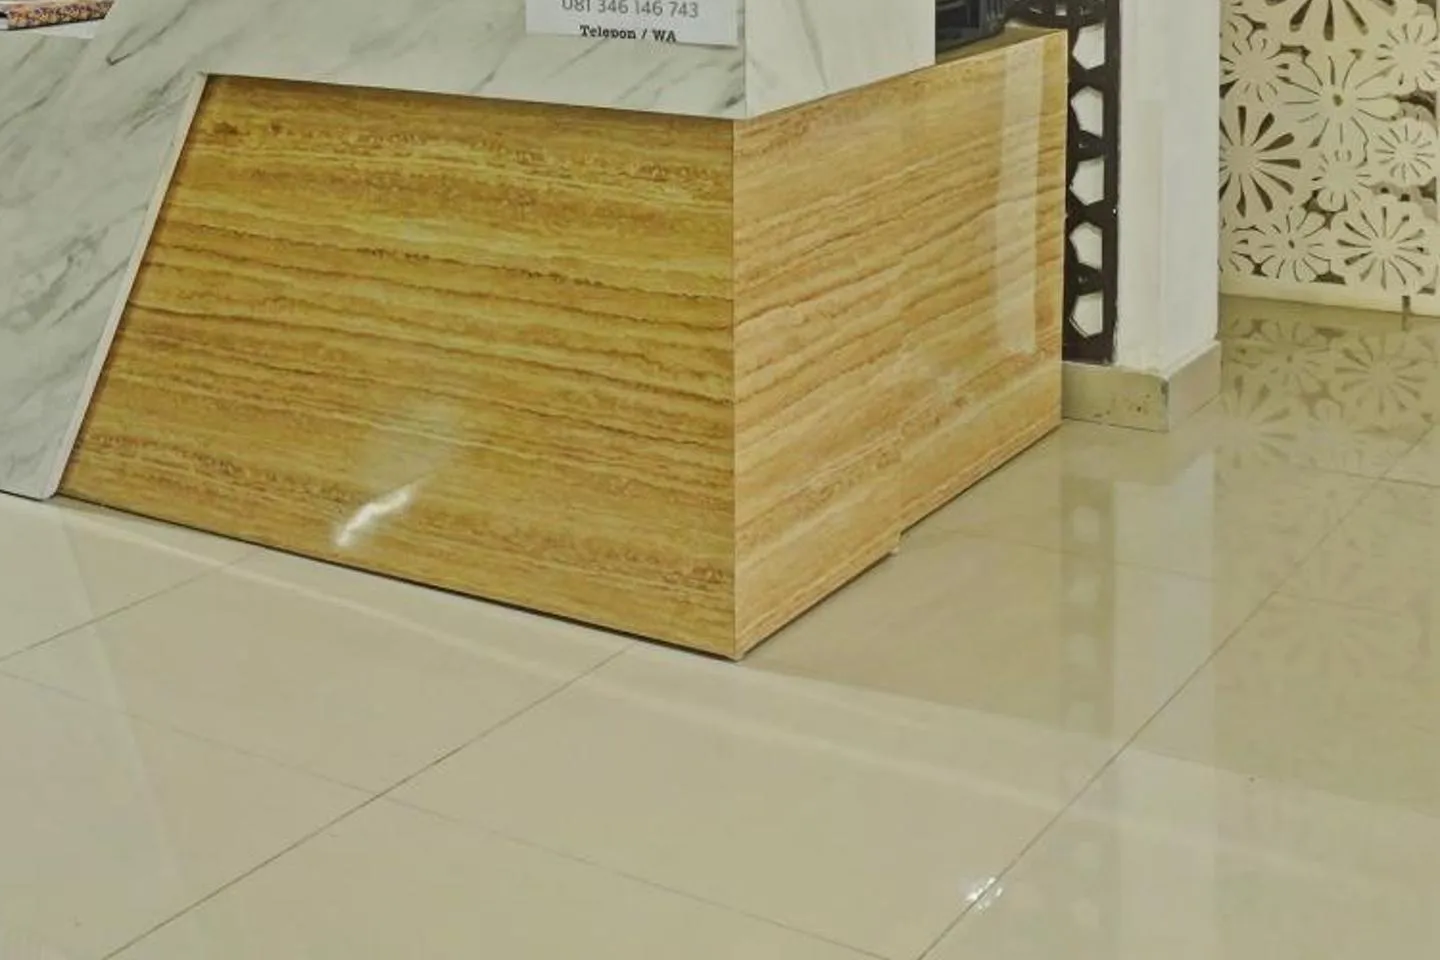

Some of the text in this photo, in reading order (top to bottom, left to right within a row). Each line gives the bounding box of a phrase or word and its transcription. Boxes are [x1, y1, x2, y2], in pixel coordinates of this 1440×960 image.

[634, 0, 663, 16] 146
[669, 2, 699, 19] 743
[652, 29, 677, 43] WA
